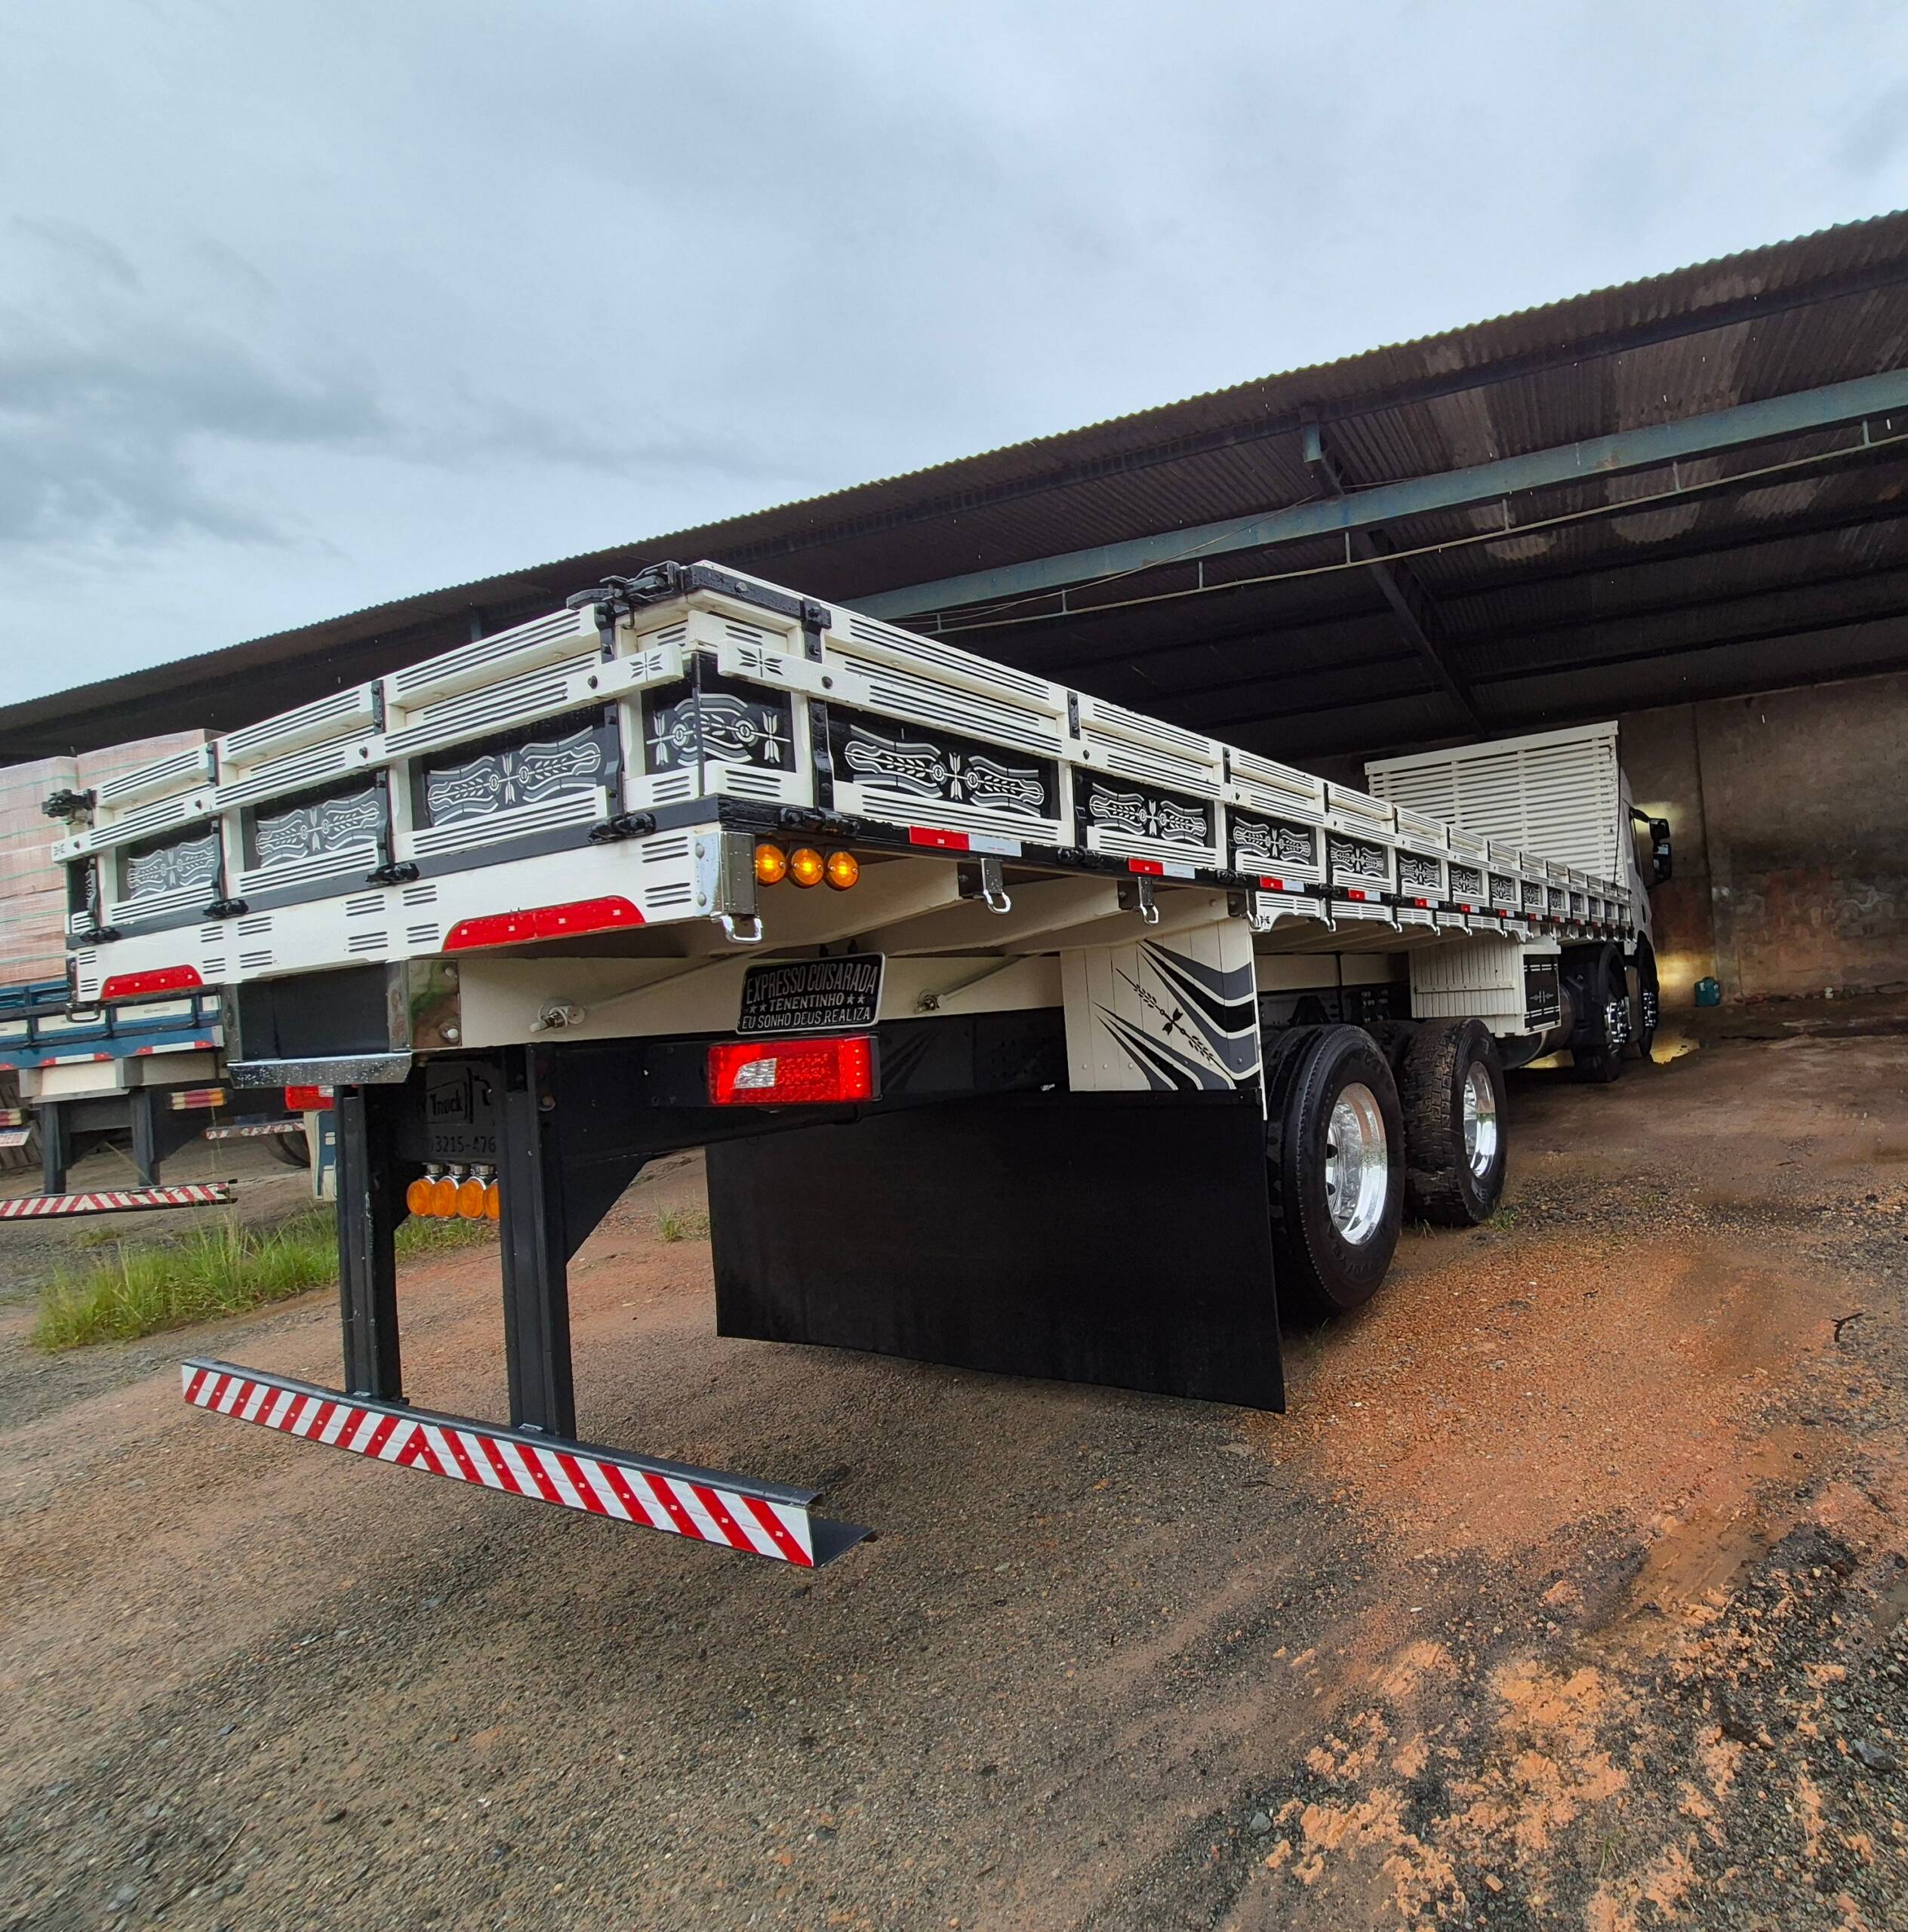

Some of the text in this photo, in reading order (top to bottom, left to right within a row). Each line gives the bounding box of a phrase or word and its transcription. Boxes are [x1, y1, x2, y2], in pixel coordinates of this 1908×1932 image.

[746, 962, 879, 1004] EXPRESSO COISARADA
[769, 992, 845, 1012] TENENTINHO
[742, 1006, 871, 1029] EU SONHO DEUS REALIZA
